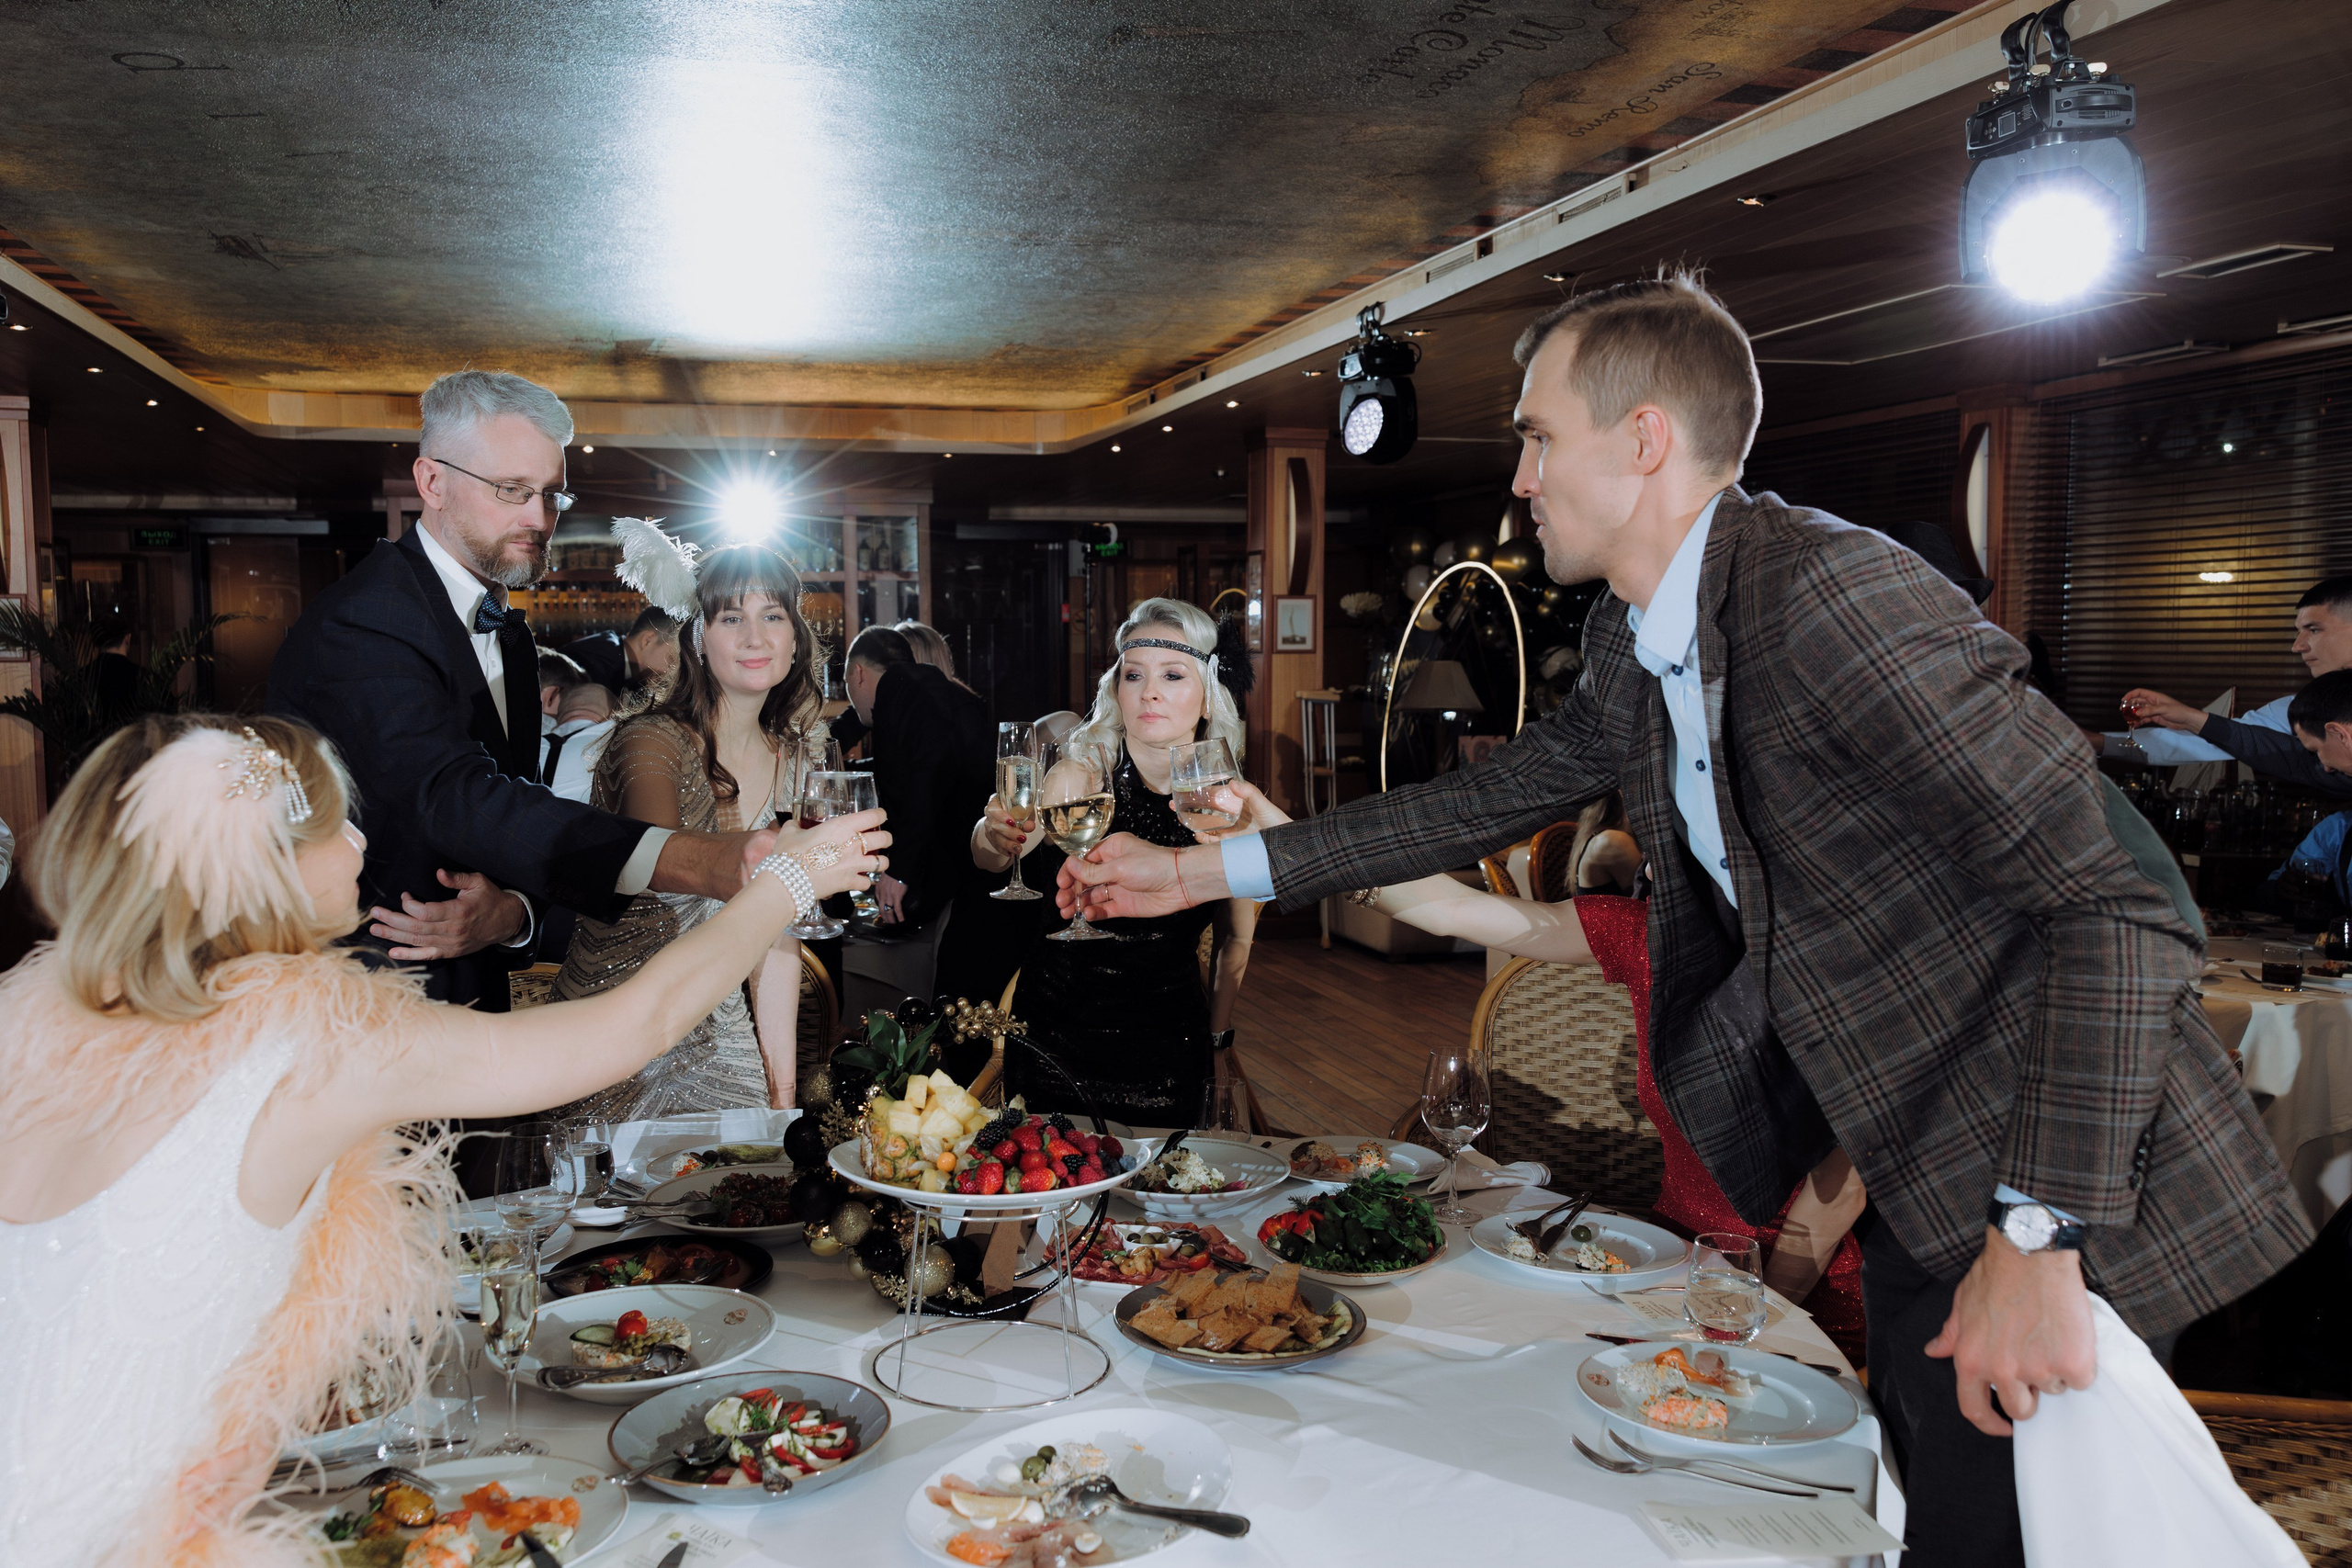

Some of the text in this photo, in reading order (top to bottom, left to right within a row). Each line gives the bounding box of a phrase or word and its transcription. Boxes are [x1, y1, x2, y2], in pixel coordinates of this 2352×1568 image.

[1416, 16, 1586, 98] Monaco
[1567, 62, 1723, 138] San Remo
